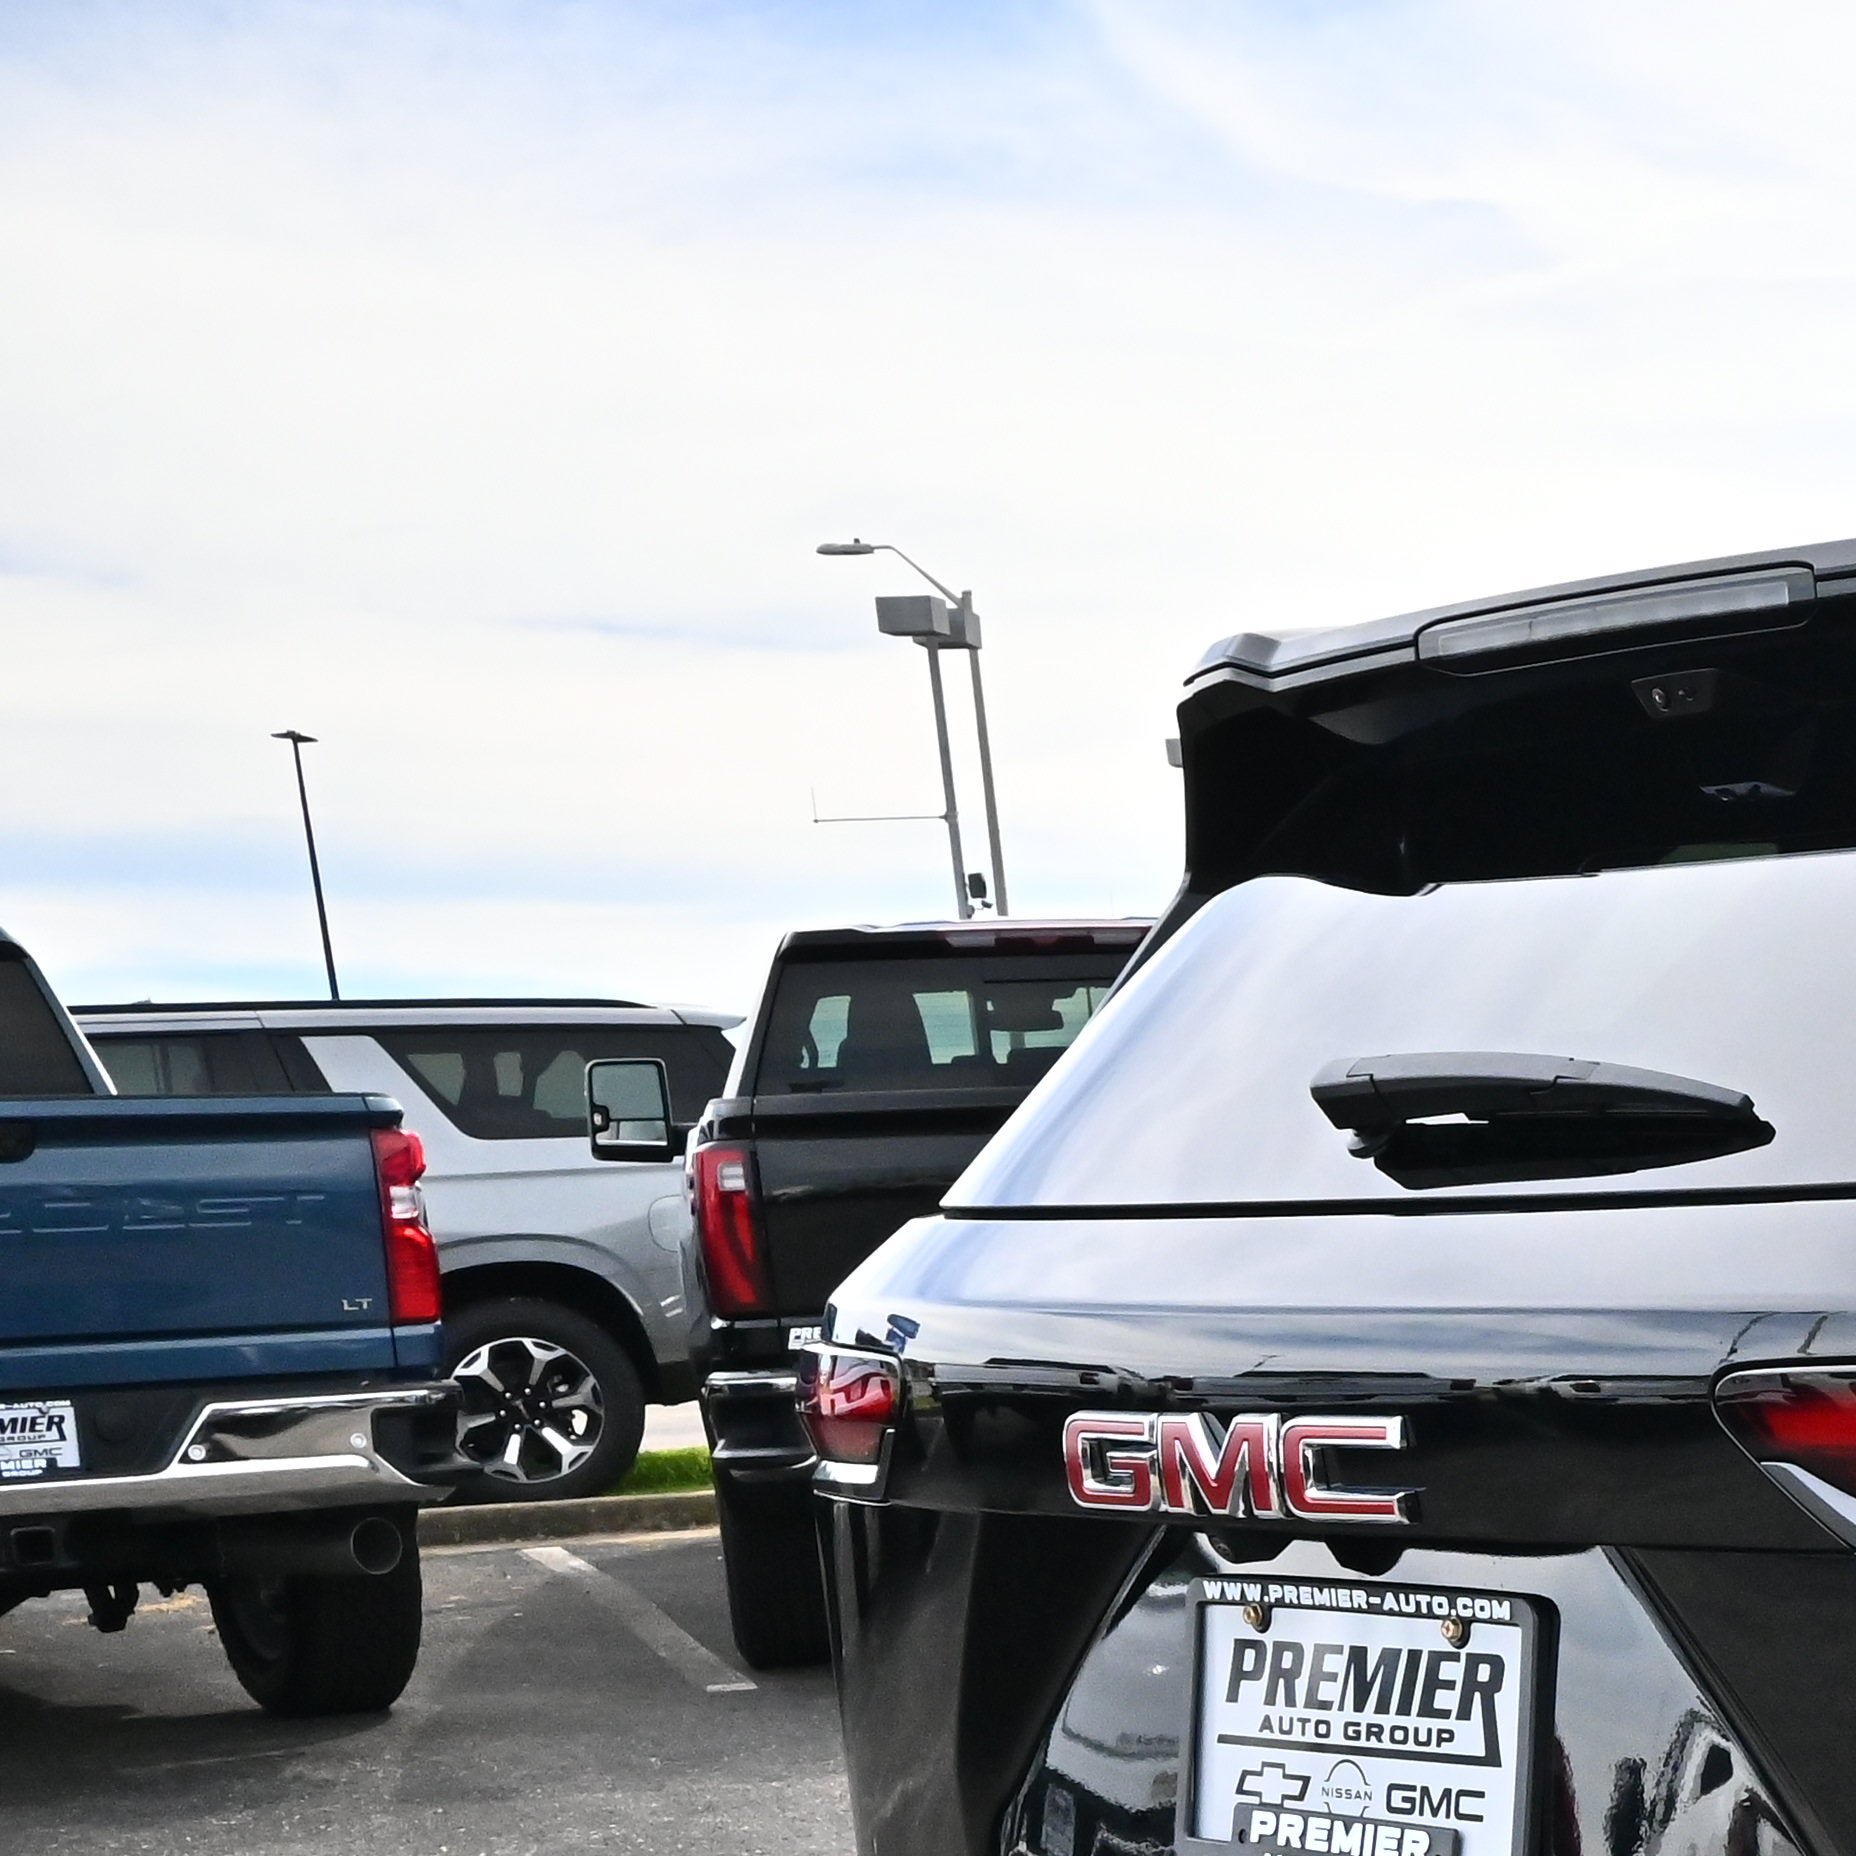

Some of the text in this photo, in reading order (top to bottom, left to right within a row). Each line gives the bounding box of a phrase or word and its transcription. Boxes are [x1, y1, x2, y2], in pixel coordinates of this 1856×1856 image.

[341, 1298, 373, 1311] LT
[19, 1447, 63, 1457] GMC
[1062, 1410, 1420, 1525] GMC
[1202, 1580, 1511, 1621] WWW.PREMIER-AUTO.COM
[1224, 1638, 1506, 1722] PREMIER
[1258, 1714, 1456, 1748] AUTO GROUP
[1321, 1786, 1373, 1802] NISSAN
[1385, 1783, 1486, 1823] GMC
